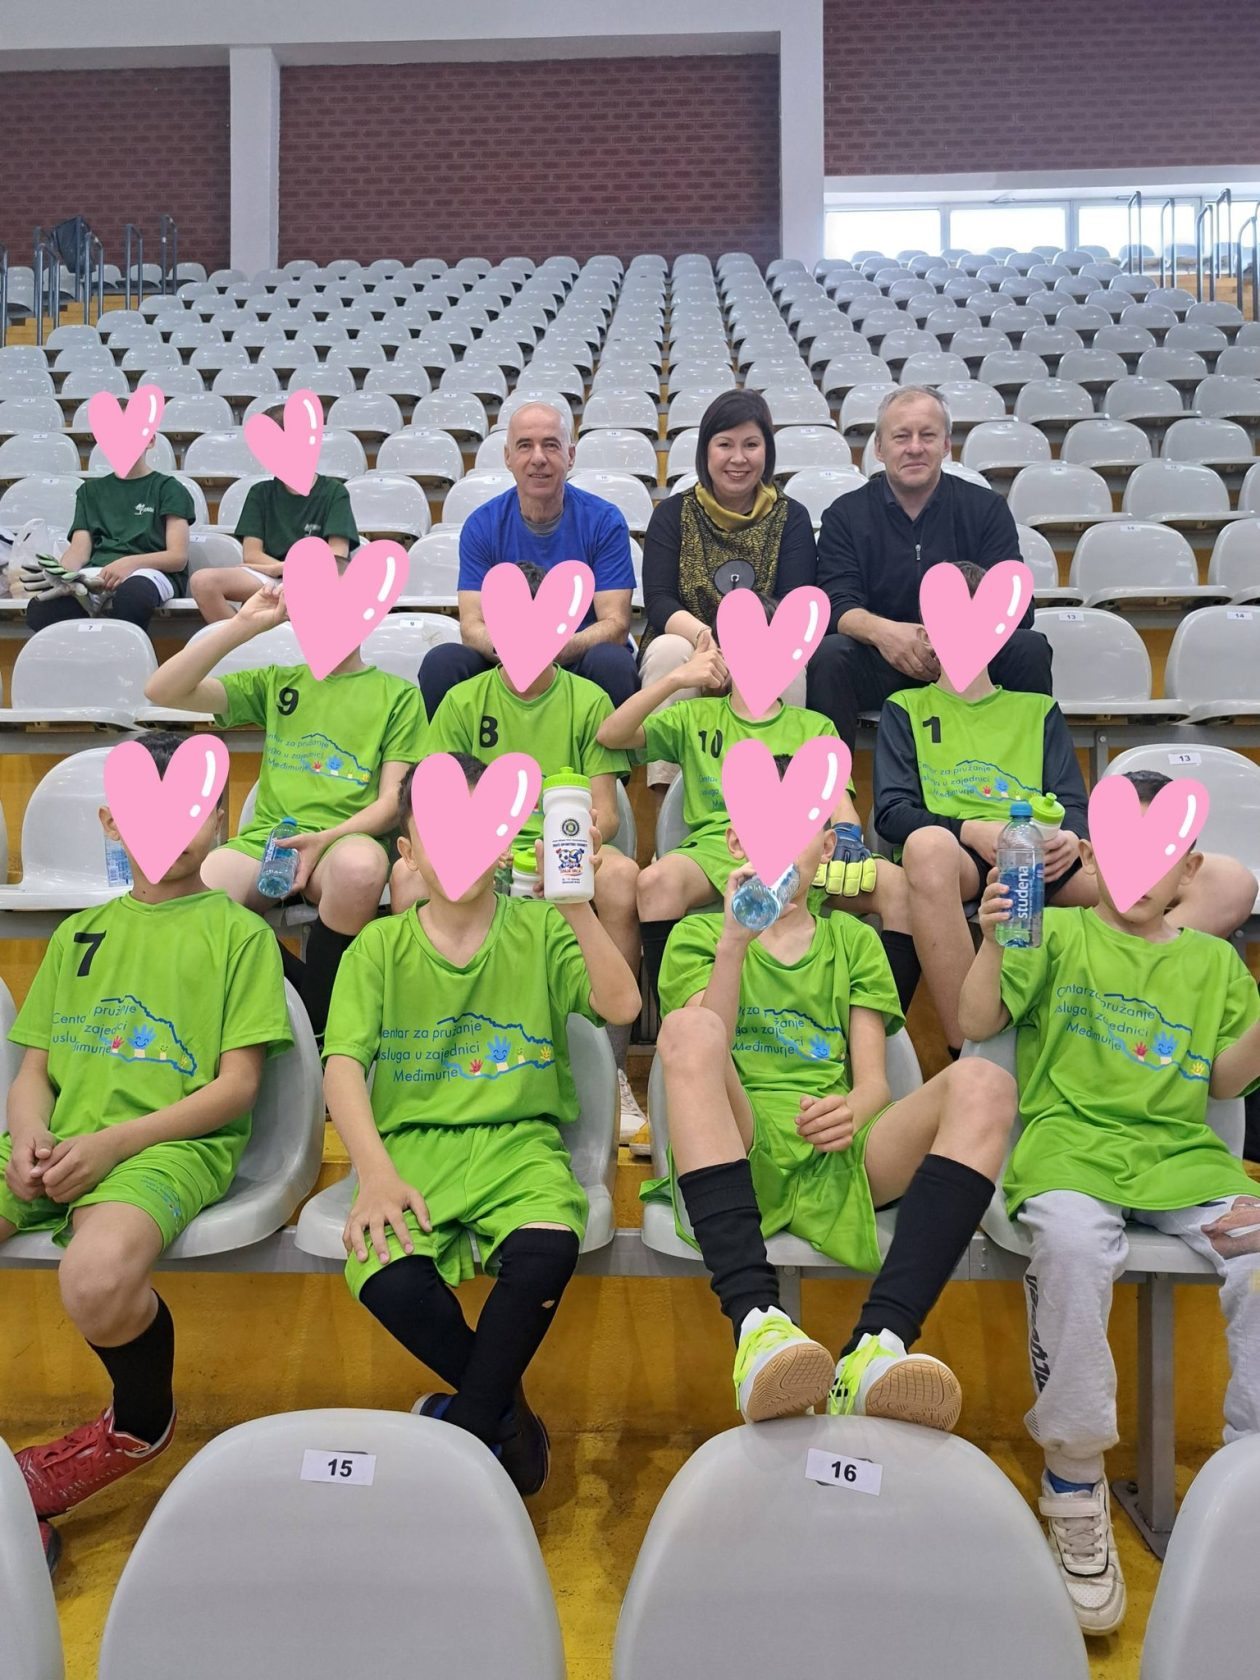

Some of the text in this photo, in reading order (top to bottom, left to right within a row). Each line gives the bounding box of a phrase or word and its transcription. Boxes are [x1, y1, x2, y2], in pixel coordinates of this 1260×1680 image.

[277, 687, 299, 716] 9
[479, 715, 499, 748] 8
[922, 716, 942, 743] 1
[698, 729, 723, 758] 10
[1014, 865, 1029, 919] studena
[74, 930, 107, 977] 7
[381, 1021, 482, 1041] entar za pružanje
[415, 1051, 423, 1060] u
[425, 1041, 481, 1062] zajednici
[393, 1069, 458, 1083] Međimurje
[328, 1458, 353, 1477] 15
[831, 1461, 857, 1482] 16
